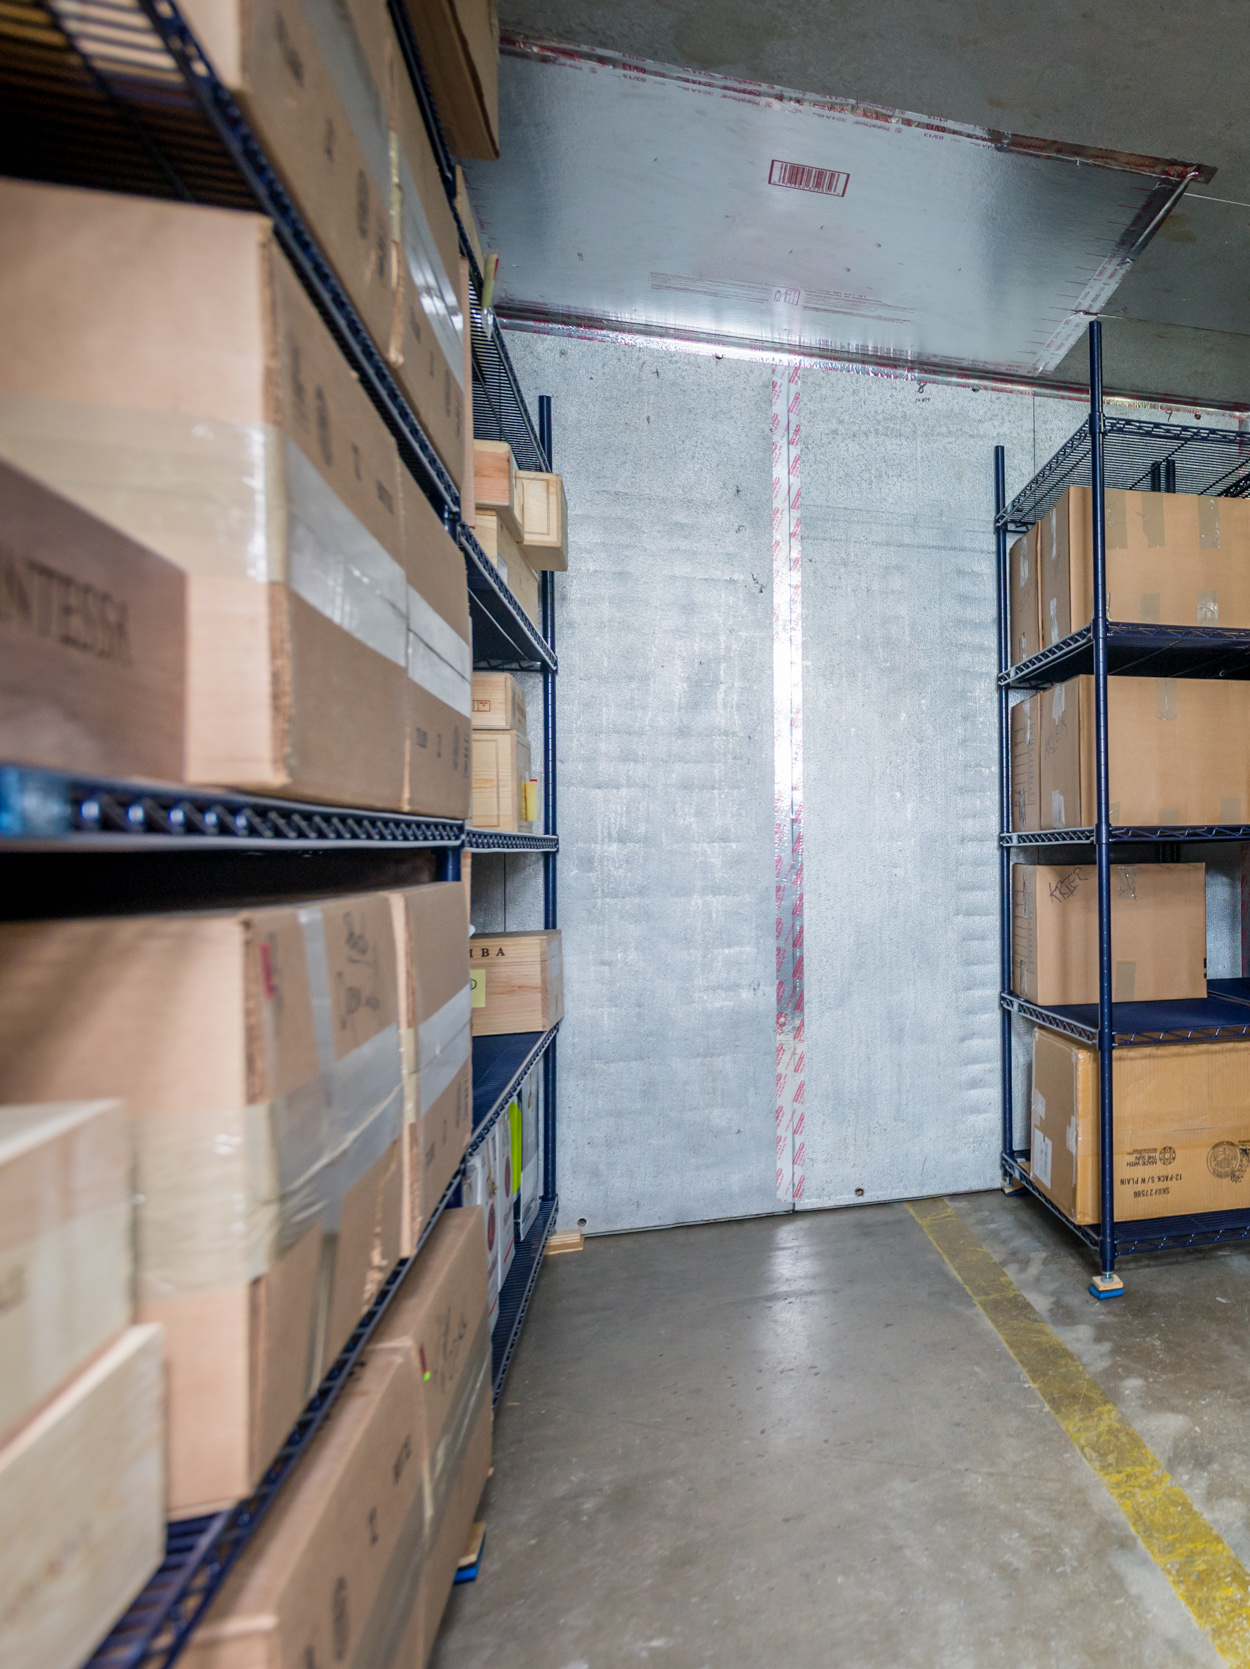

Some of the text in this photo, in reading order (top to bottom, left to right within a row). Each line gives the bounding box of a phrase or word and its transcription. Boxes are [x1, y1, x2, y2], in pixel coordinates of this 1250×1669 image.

[1120, 1173, 1182, 1186] 12-PACK S/W PLAIN
